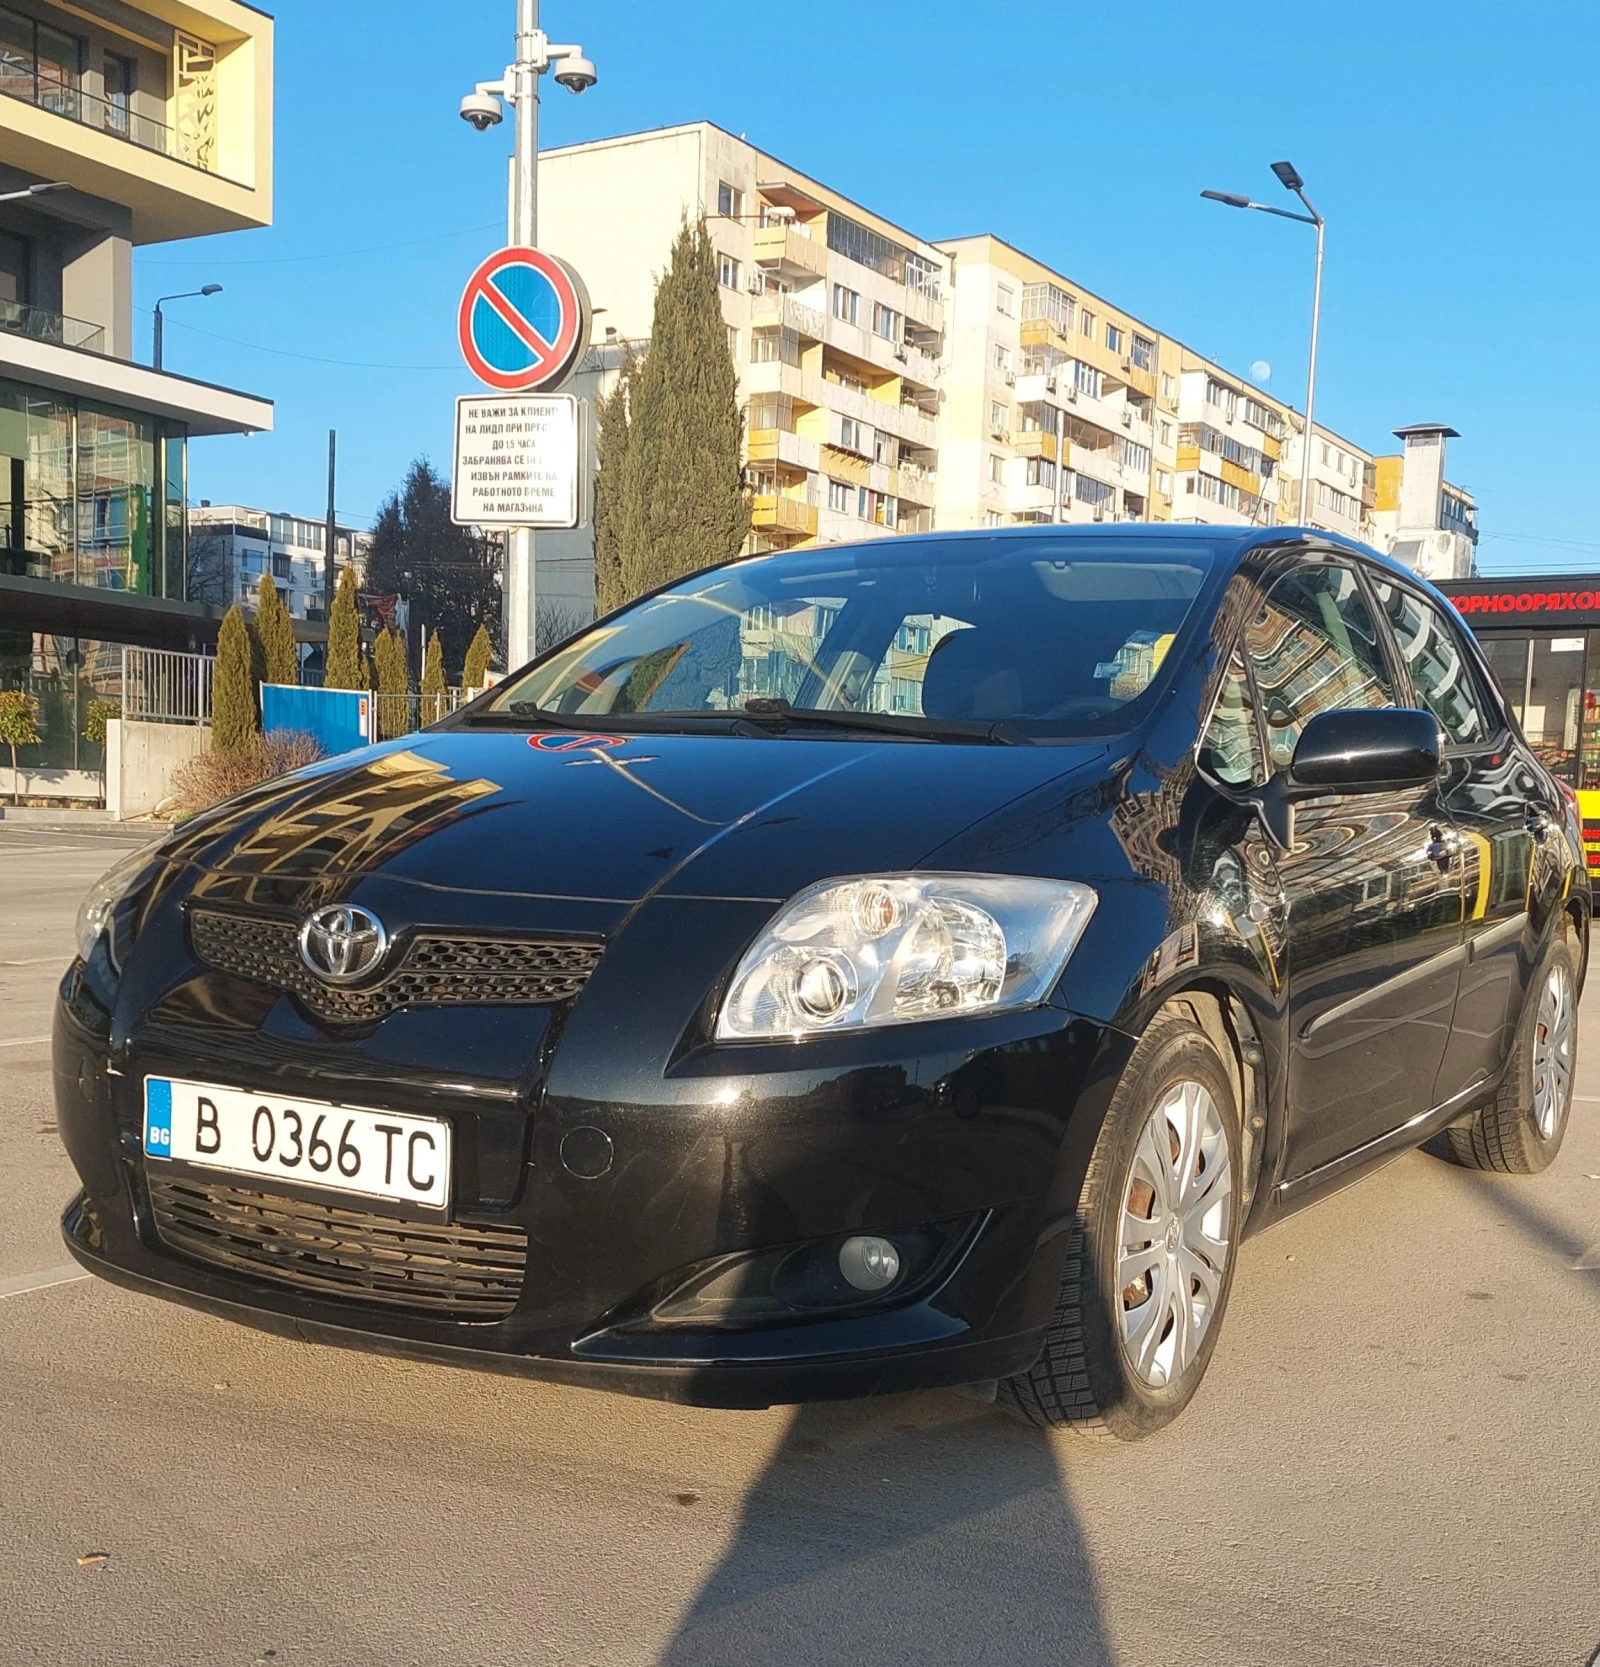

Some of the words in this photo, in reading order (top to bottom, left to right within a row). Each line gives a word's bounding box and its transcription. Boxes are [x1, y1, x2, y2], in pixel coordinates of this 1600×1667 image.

[468, 408, 479, 418] НЕ
[481, 407, 506, 418] ВАЖИ
[508, 407, 518, 417] ЗА
[520, 406, 558, 417] КЛИЕНТ
[465, 424, 477, 434] НА
[479, 424, 504, 435] ЛИДЛ
[505, 423, 522, 433] ПРИ
[492, 440, 504, 451] ДО
[517, 439, 536, 449] ЧАСА
[462, 455, 512, 466] ЗАБРАНЯВА
[514, 455, 525, 465] СЕ
[471, 471, 500, 481] ИЗВЪН
[472, 487, 522, 497] РАБОТНОТО
[524, 487, 555, 497] ВРЕМЕ
[483, 503, 495, 513] НА
[497, 503, 544, 513] МАГАЗИНА
[149, 1127, 170, 1146] BG
[195, 1096, 221, 1154] B
[252, 1105, 362, 1178] 0366
[374, 1123, 436, 1192] TC
